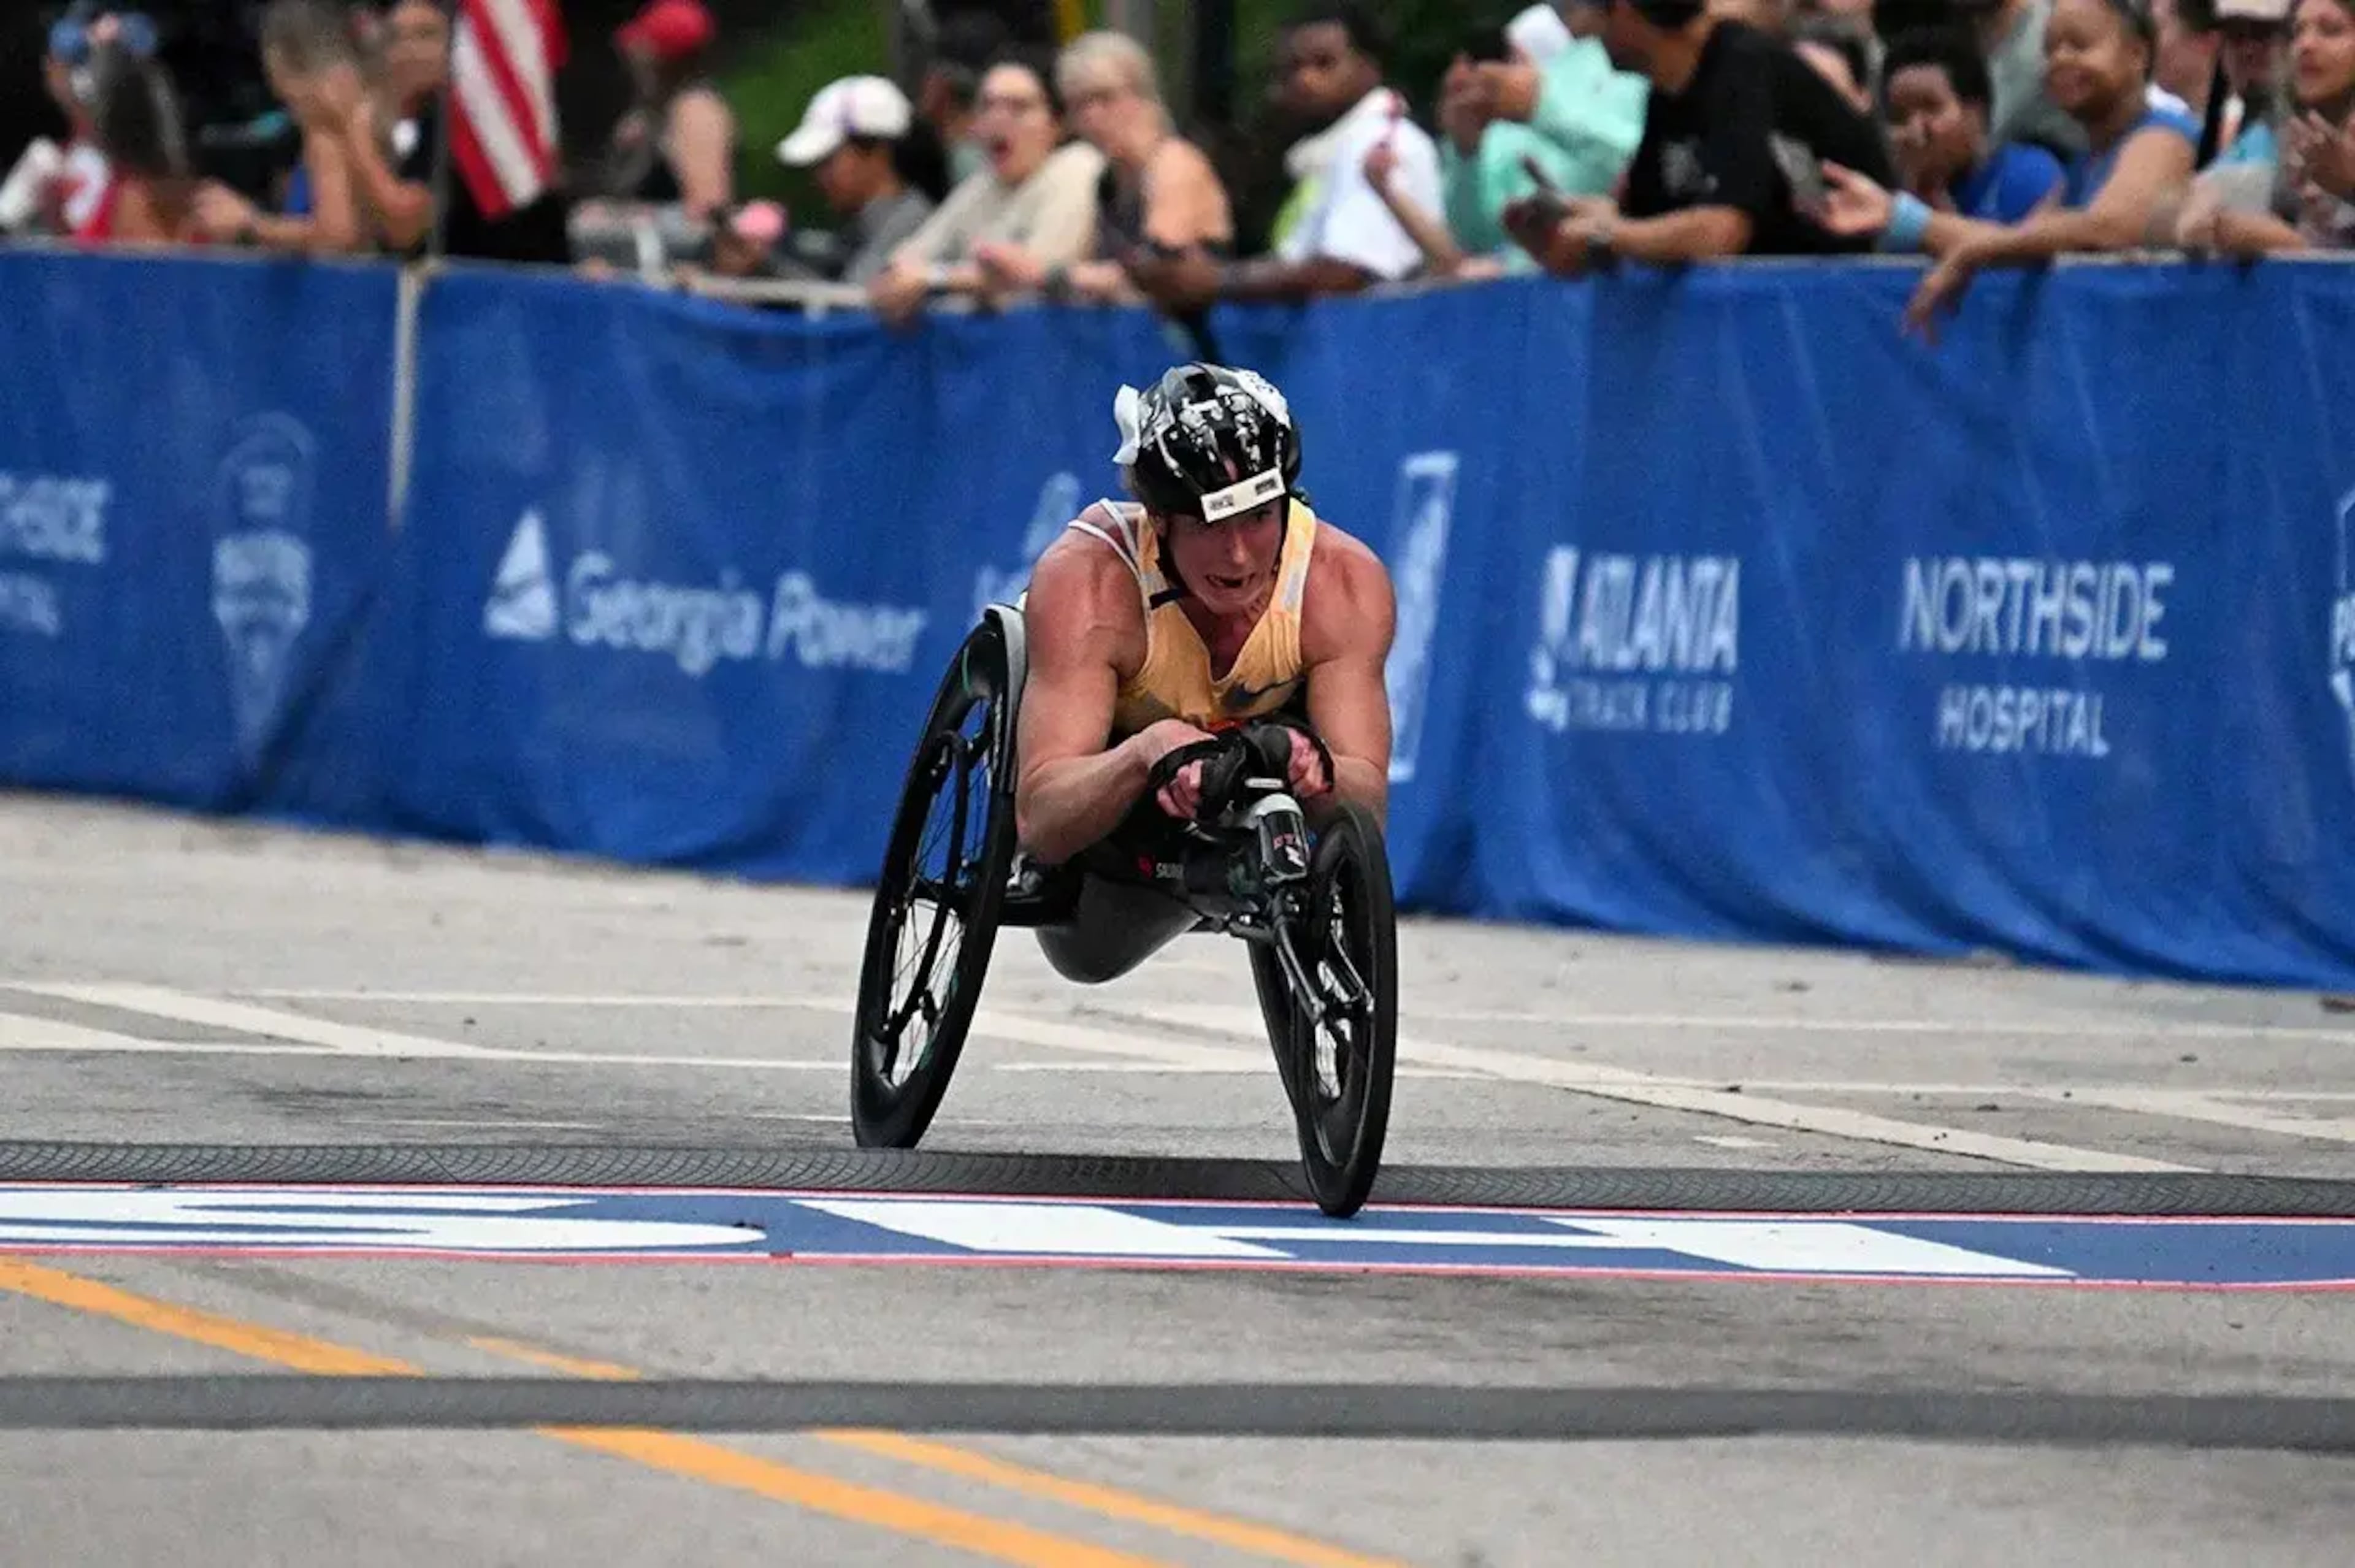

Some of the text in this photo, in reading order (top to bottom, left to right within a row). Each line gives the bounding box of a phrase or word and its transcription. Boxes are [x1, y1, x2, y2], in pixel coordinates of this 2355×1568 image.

[568, 549, 926, 676] Georgia Power
[1579, 554, 1739, 674] ATLANTA
[1899, 557, 2175, 659] NORTHSIDE
[1656, 679, 1734, 734] CLUB
[1938, 684, 2110, 758] HOSPITAL
